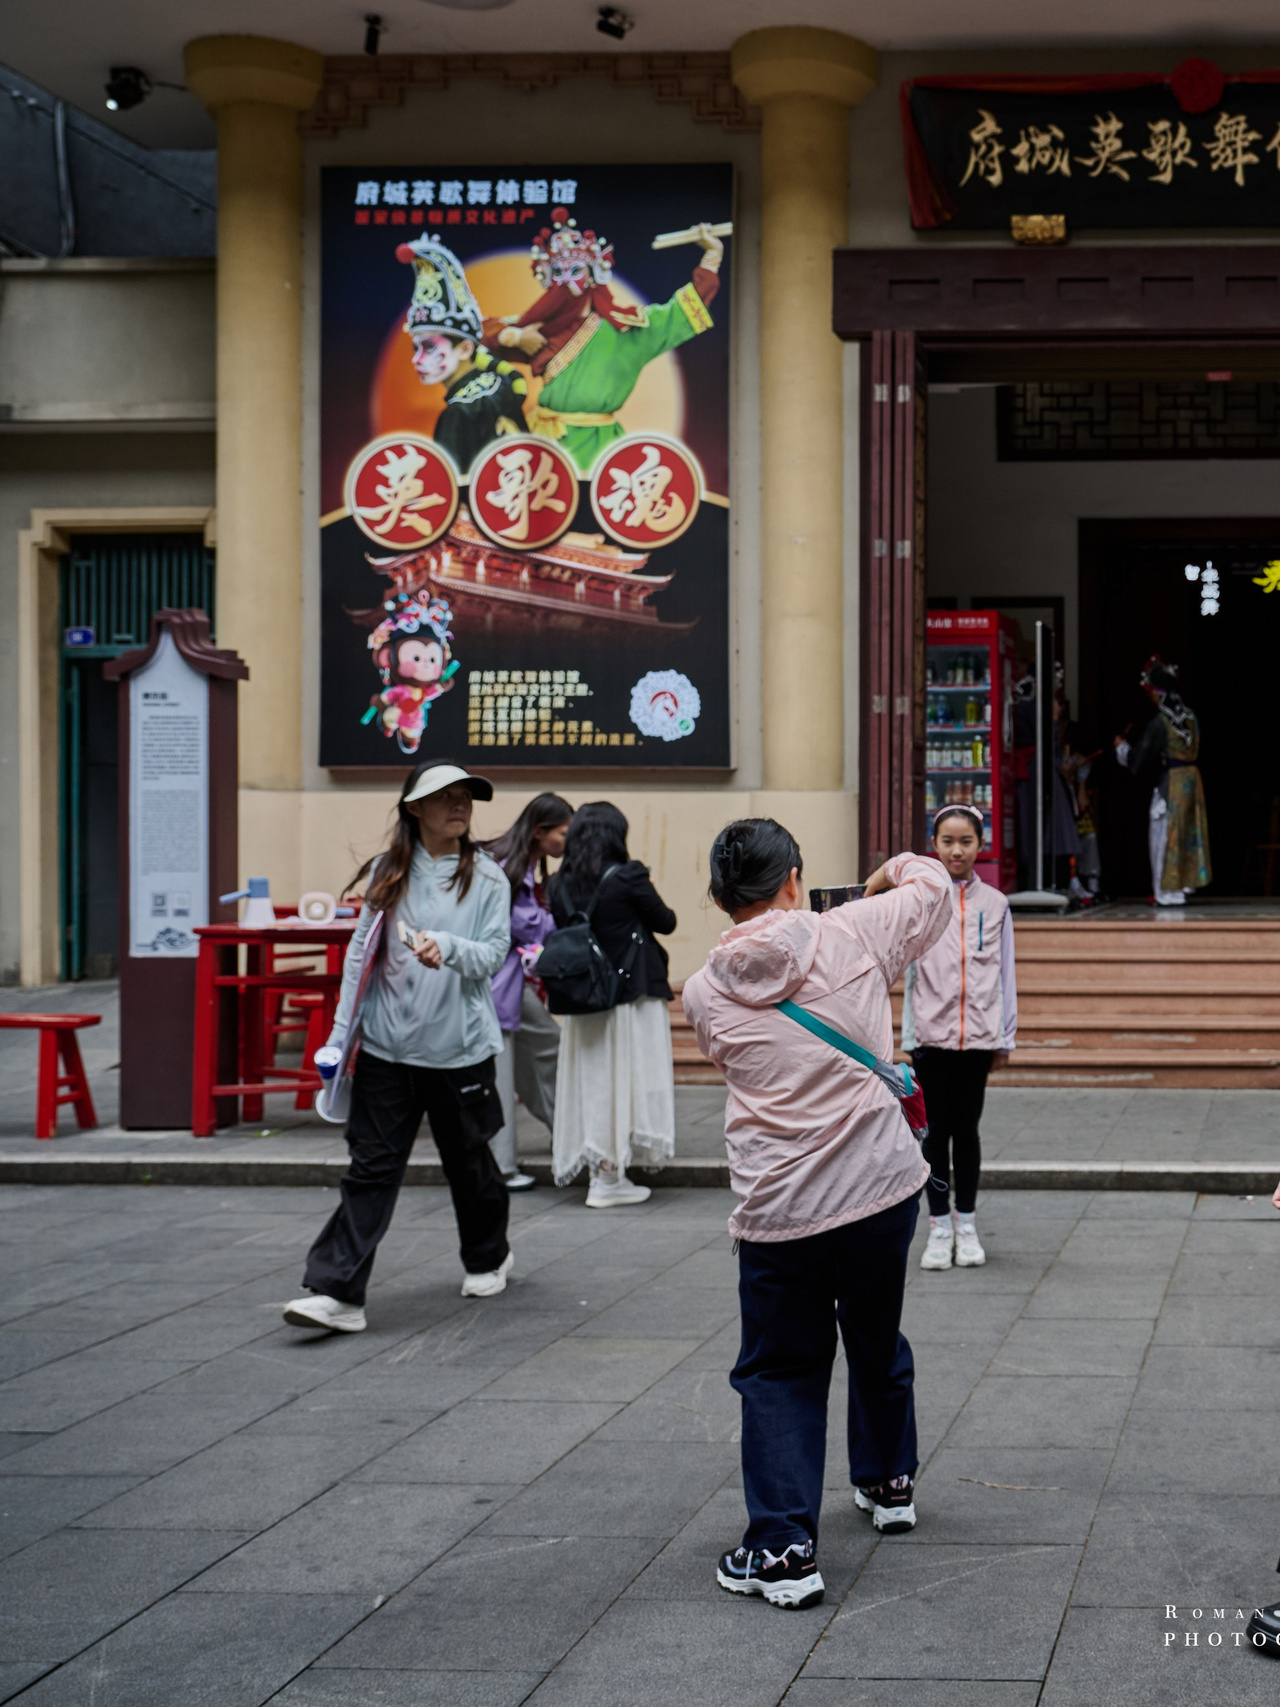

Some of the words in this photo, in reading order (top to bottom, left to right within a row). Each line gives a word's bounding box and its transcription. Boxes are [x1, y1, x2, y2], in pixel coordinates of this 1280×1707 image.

[354, 179, 578, 206] 府城英歌舞体验馆
[353, 443, 688, 537] 英歌魂
